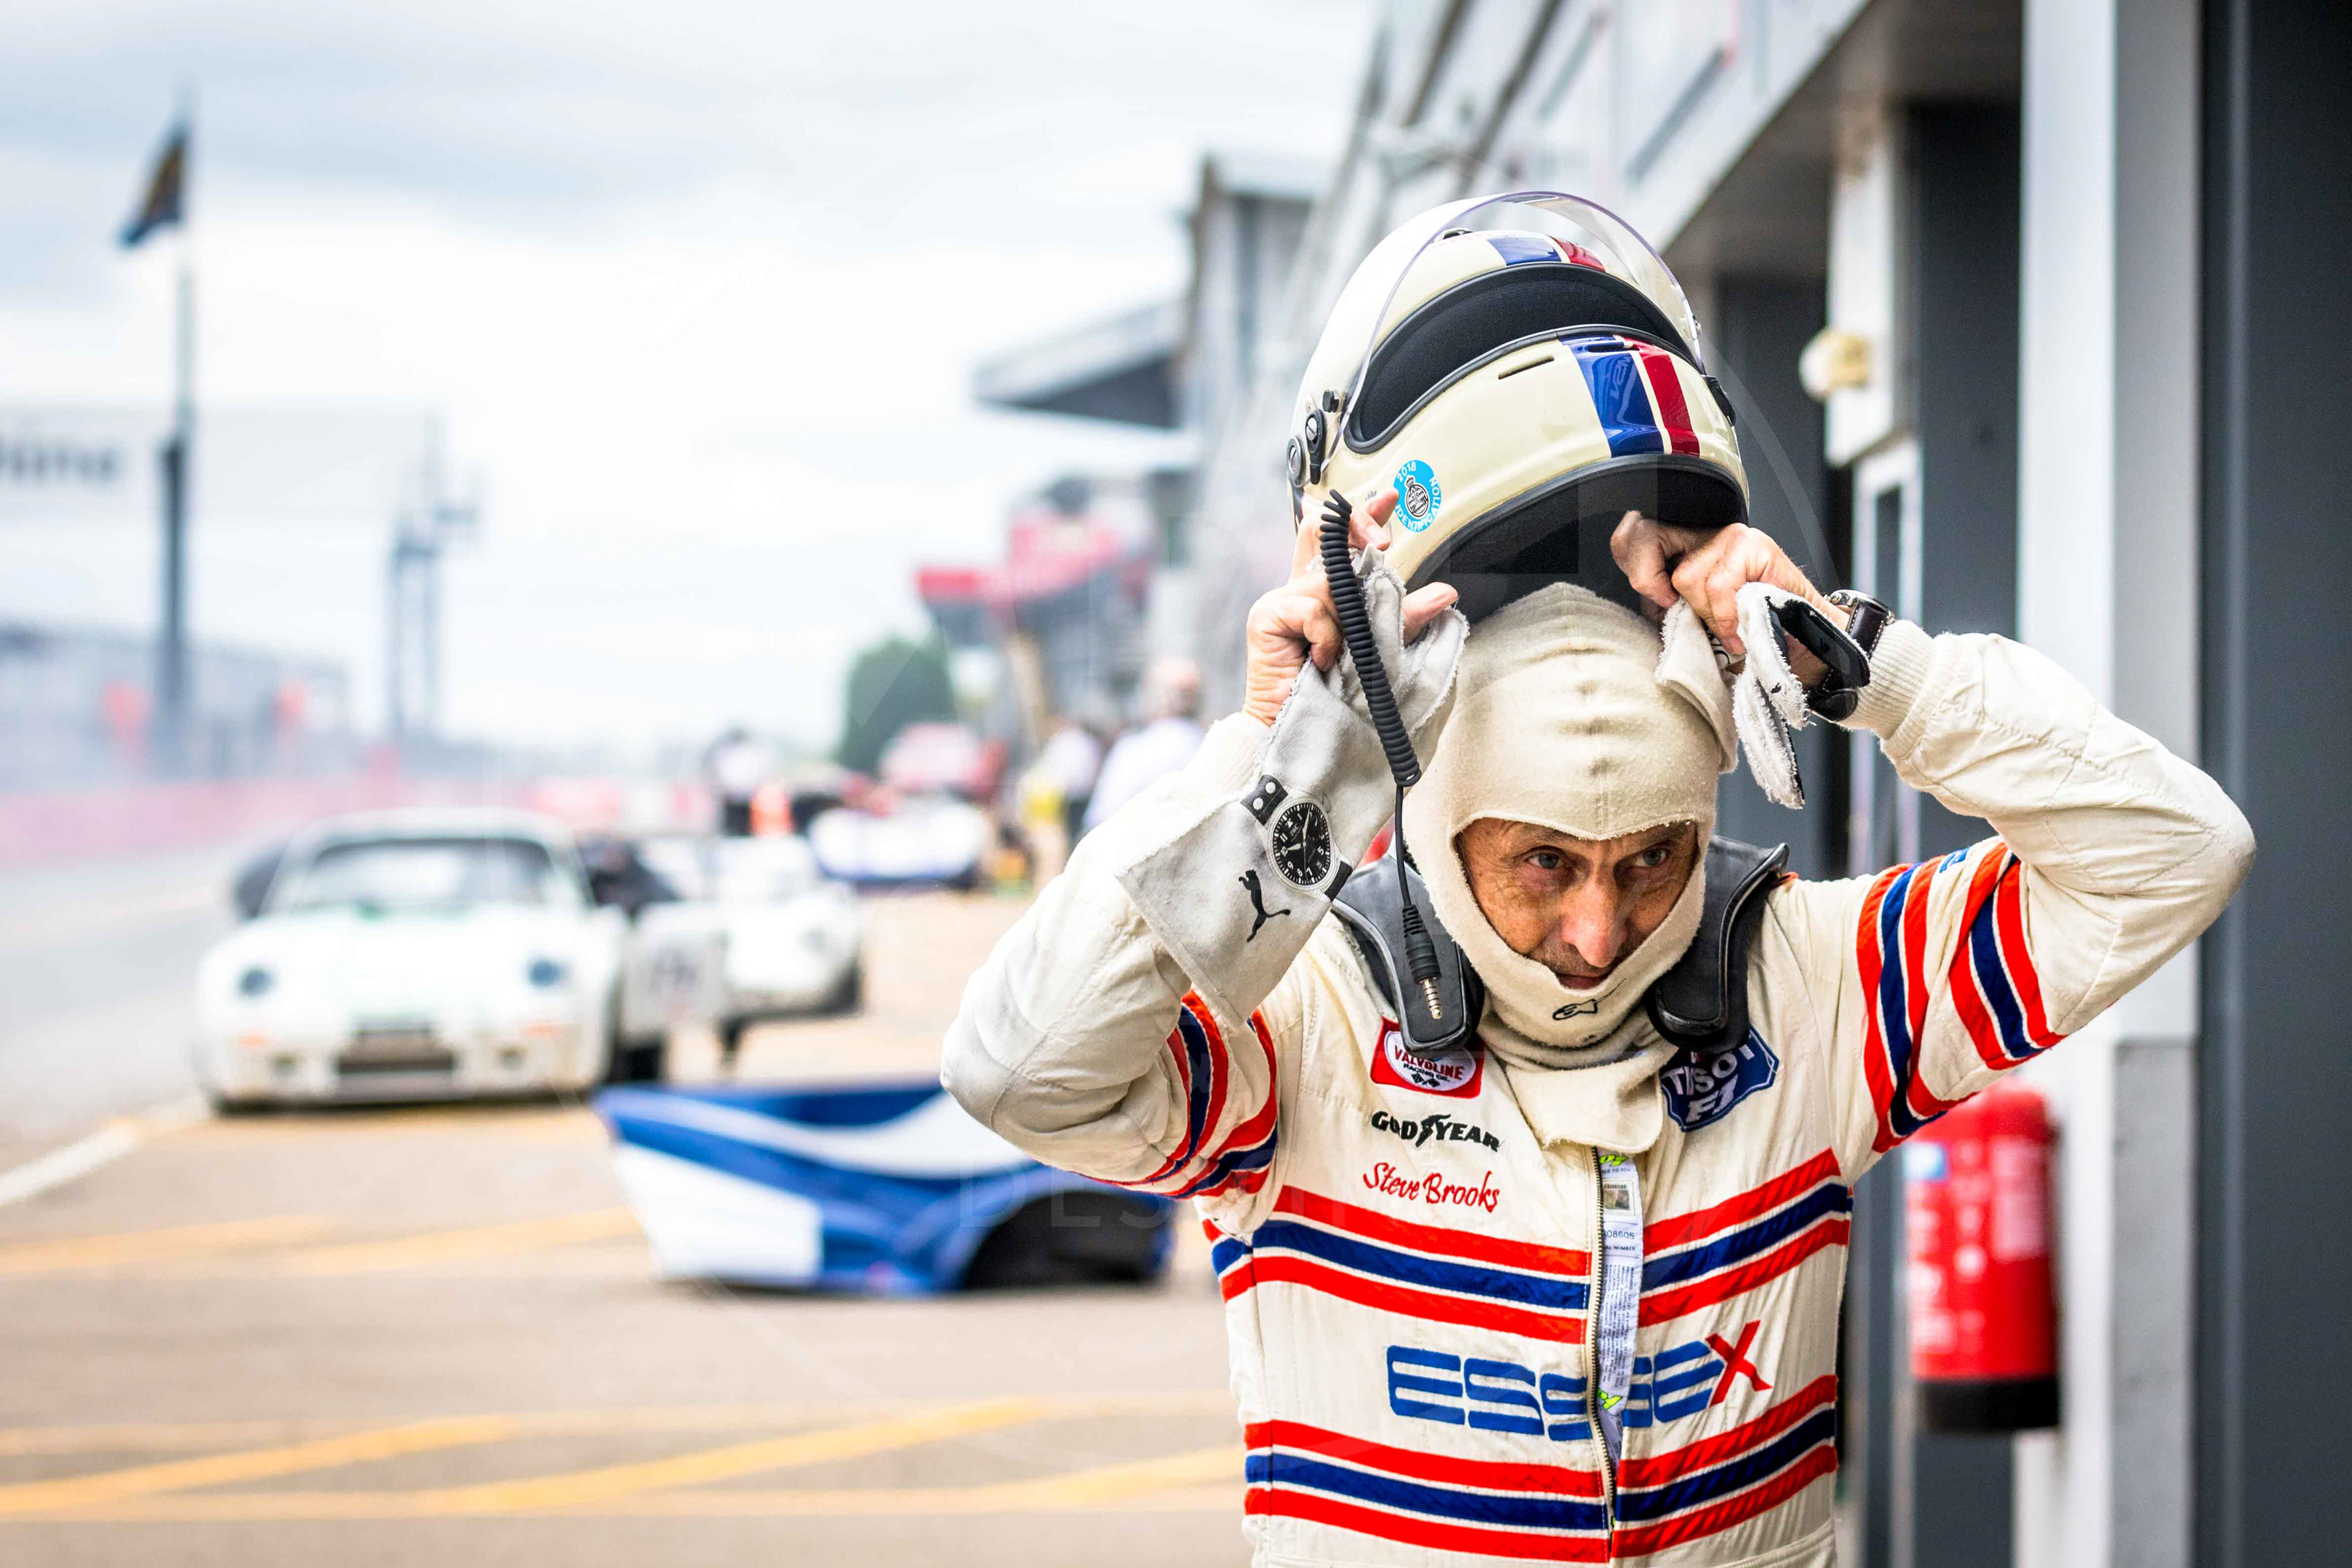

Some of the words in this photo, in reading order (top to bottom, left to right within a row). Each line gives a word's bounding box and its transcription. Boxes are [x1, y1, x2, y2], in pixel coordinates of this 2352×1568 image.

[1397, 461, 1416, 482] 2018
[1395, 477, 1441, 530] IDENTIFICATION
[1287, 861, 1294, 870] 9
[1317, 846, 1324, 856] 5
[1394, 1044, 1464, 1080] VALVOLINE
[1403, 1063, 1434, 1079] RACING
[1661, 1044, 1755, 1096] TISO
[1362, 1162, 1420, 1200] Steve
[1422, 1170, 1500, 1213] Brooks
[1386, 1319, 1773, 1441] ESSEX
